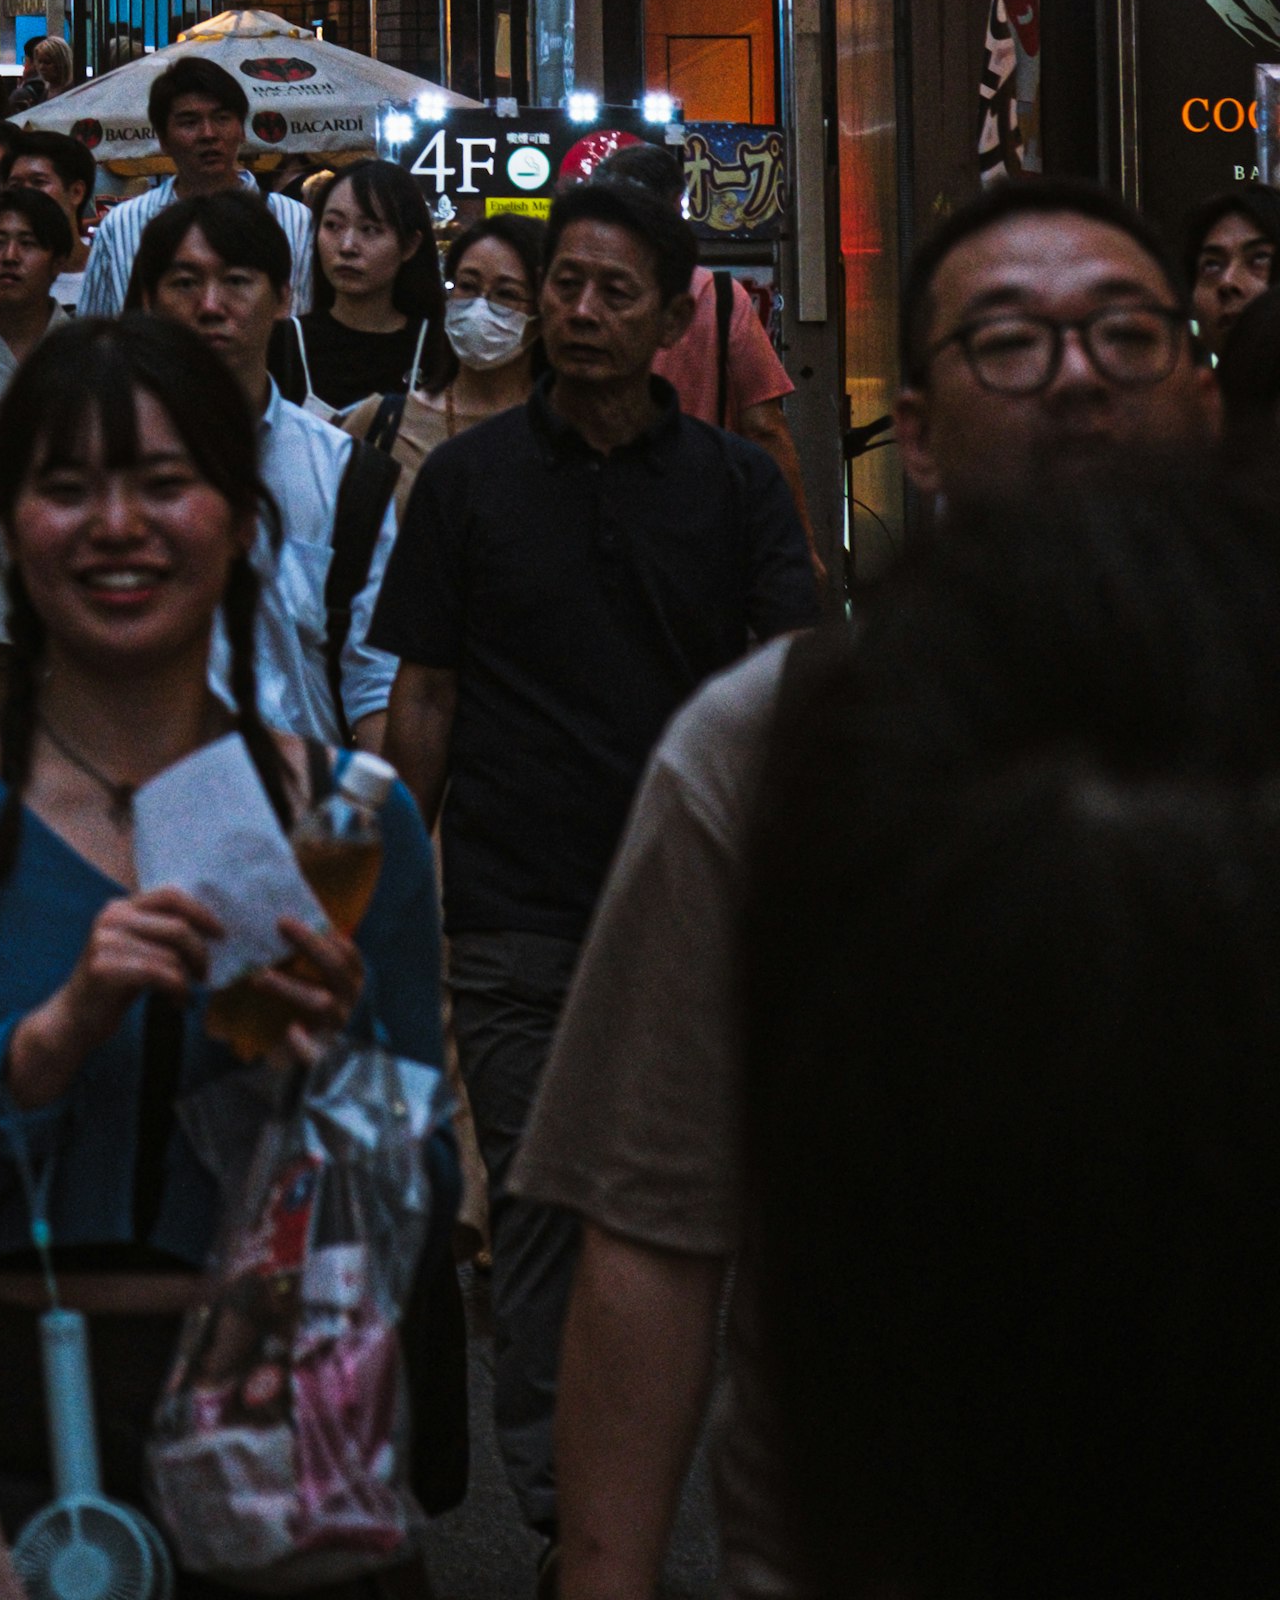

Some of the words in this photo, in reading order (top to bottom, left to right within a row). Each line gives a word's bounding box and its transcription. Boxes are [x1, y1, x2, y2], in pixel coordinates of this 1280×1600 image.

[410, 129, 497, 193] 4F
[684, 132, 784, 221] オープ
